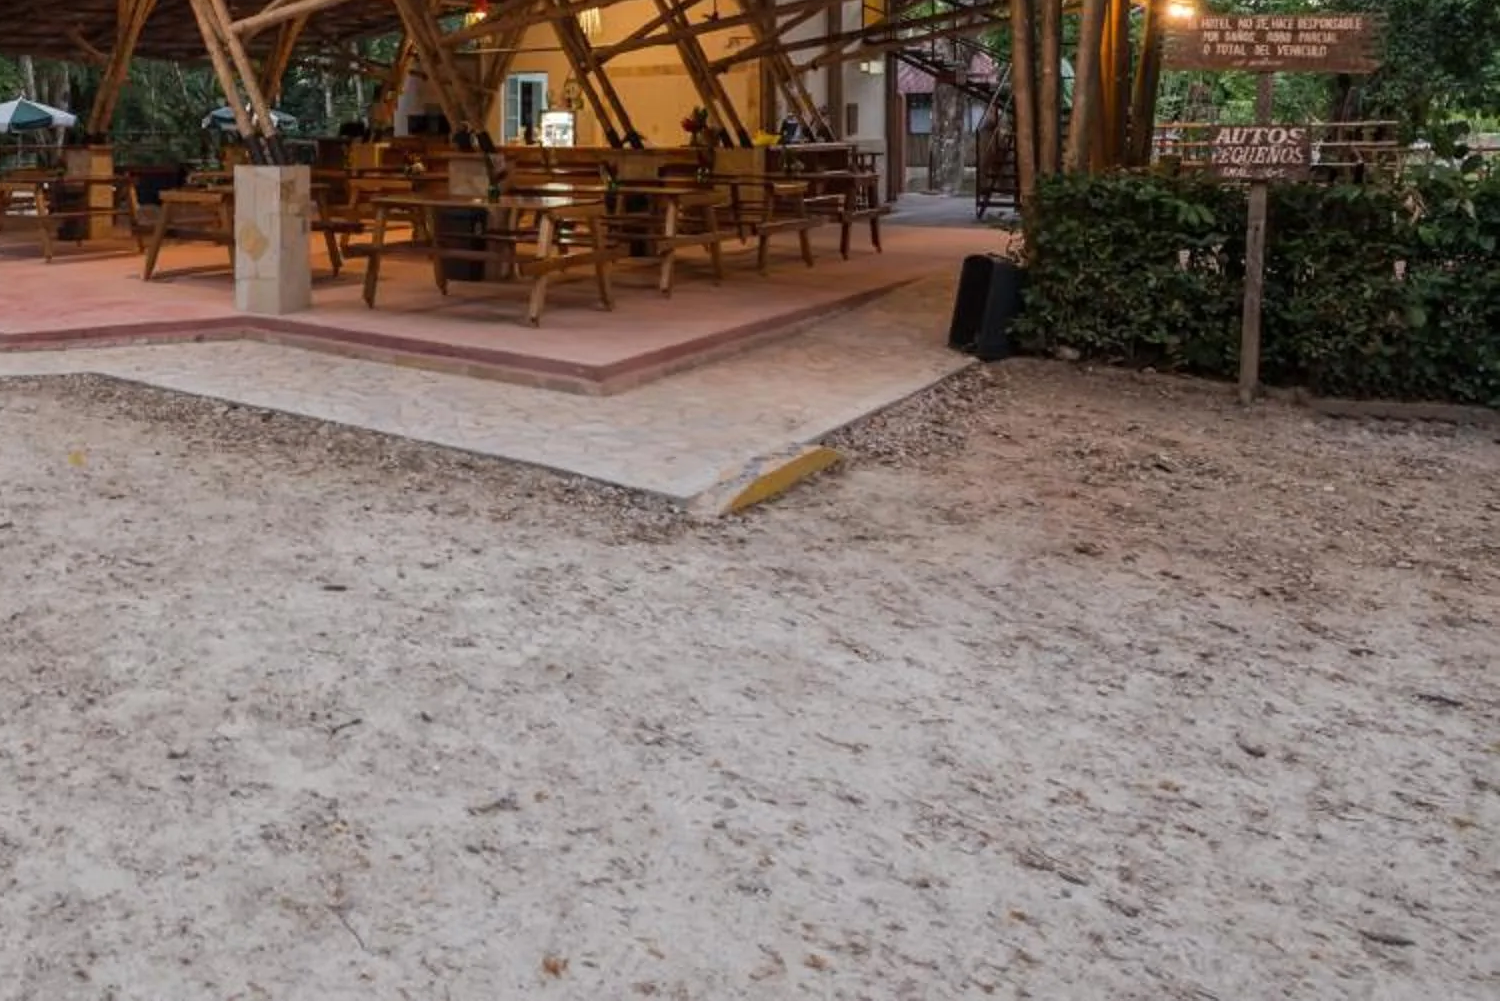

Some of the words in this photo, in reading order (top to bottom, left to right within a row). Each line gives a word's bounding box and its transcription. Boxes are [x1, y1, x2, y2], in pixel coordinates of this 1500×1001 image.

[1238, 17, 1253, 30] NO
[1215, 43, 1247, 56] TOTAL
[1215, 126, 1307, 146] AUTOS
